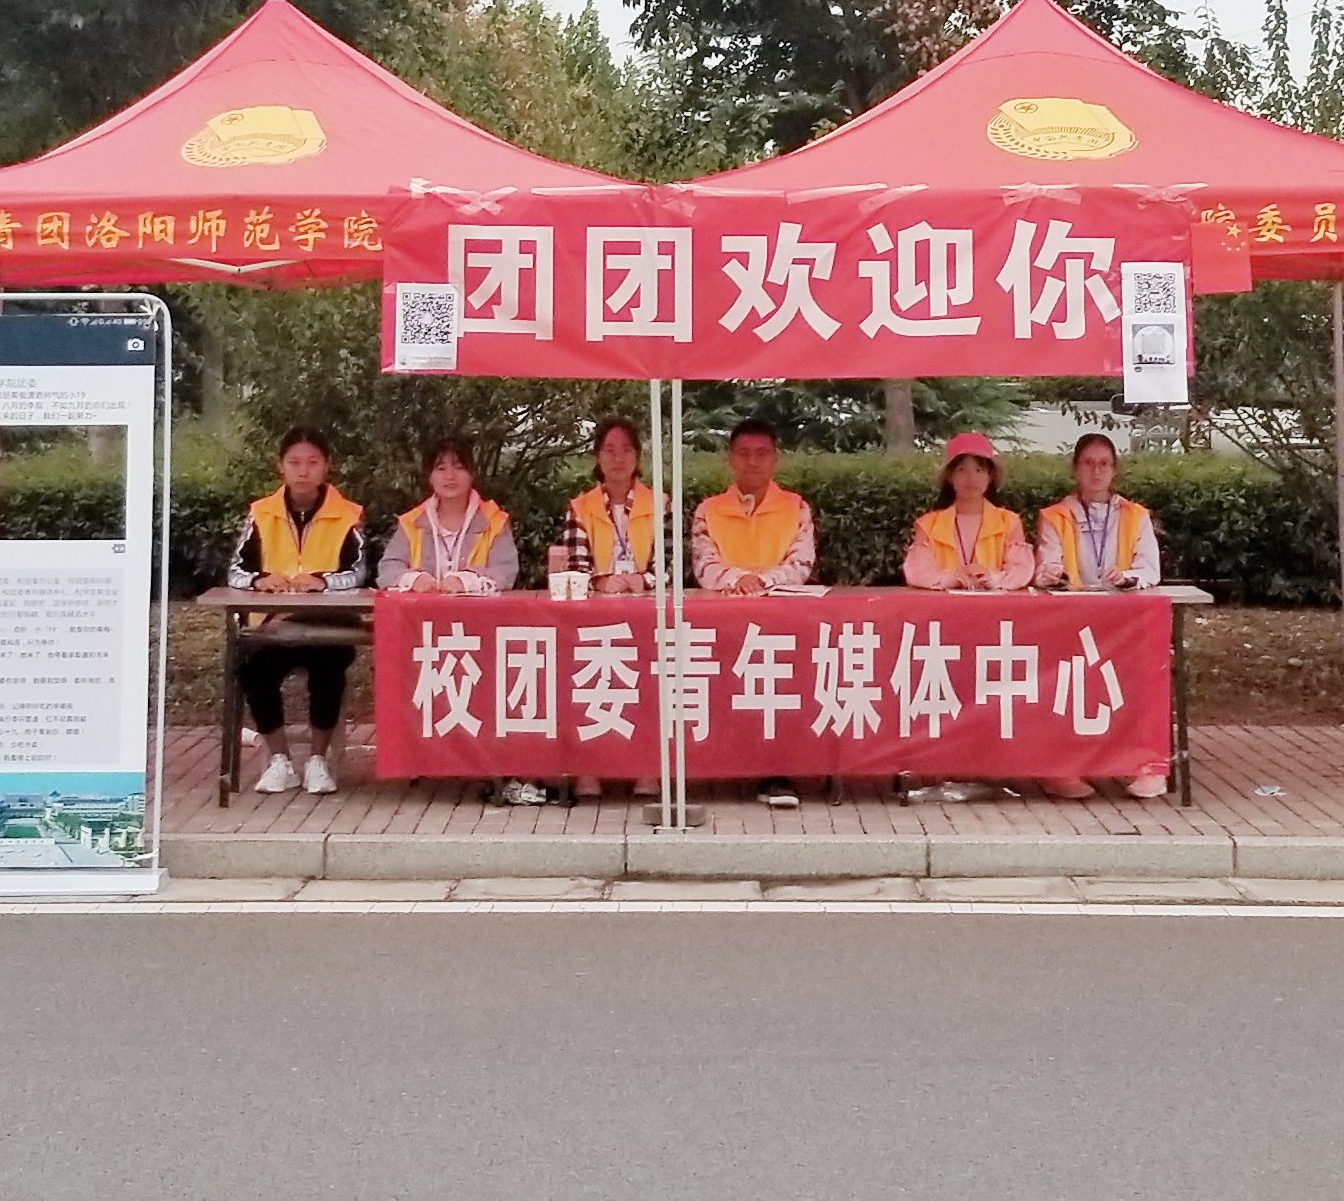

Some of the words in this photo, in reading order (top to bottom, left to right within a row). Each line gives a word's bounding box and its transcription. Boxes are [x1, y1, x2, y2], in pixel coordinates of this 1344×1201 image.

[445, 219, 1121, 342] 团团欢迎你
[413, 620, 1124, 741] 校团委青年媒体中心
